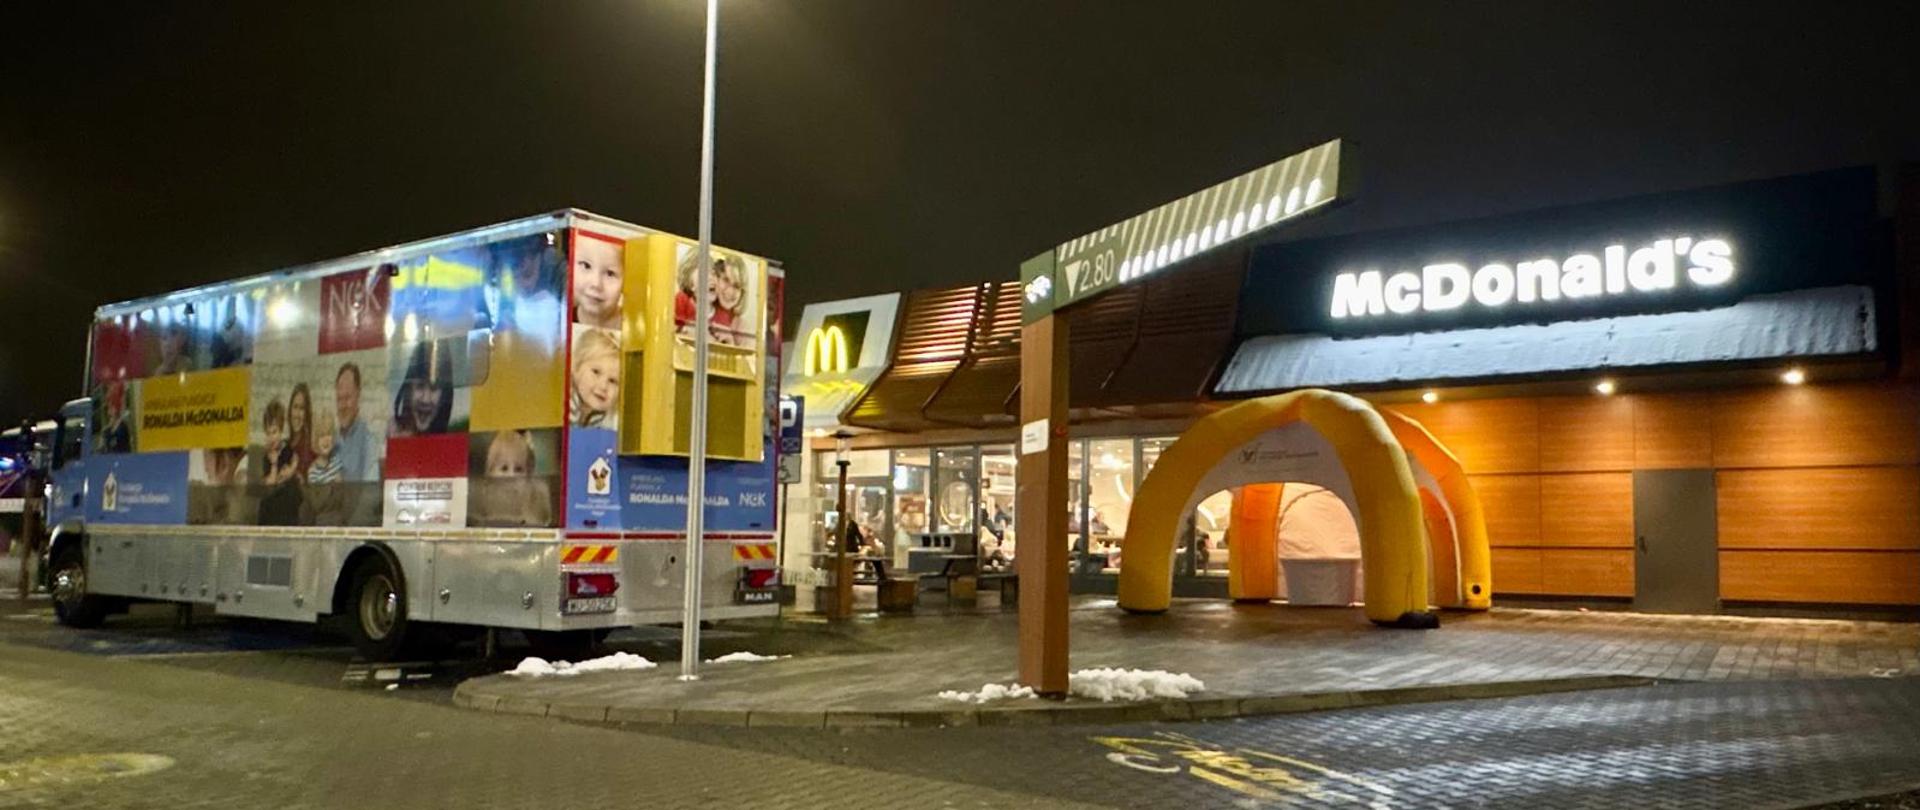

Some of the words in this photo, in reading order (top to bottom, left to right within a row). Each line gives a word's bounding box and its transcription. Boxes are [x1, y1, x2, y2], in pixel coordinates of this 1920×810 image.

[1080, 249, 1114, 292] 2.80
[1329, 237, 1735, 318] McDonald's
[143, 412, 184, 430] RONALDA
[186, 406, 244, 426] McDONALDA
[629, 492, 674, 504] RONALDA
[745, 592, 773, 601] MAN
